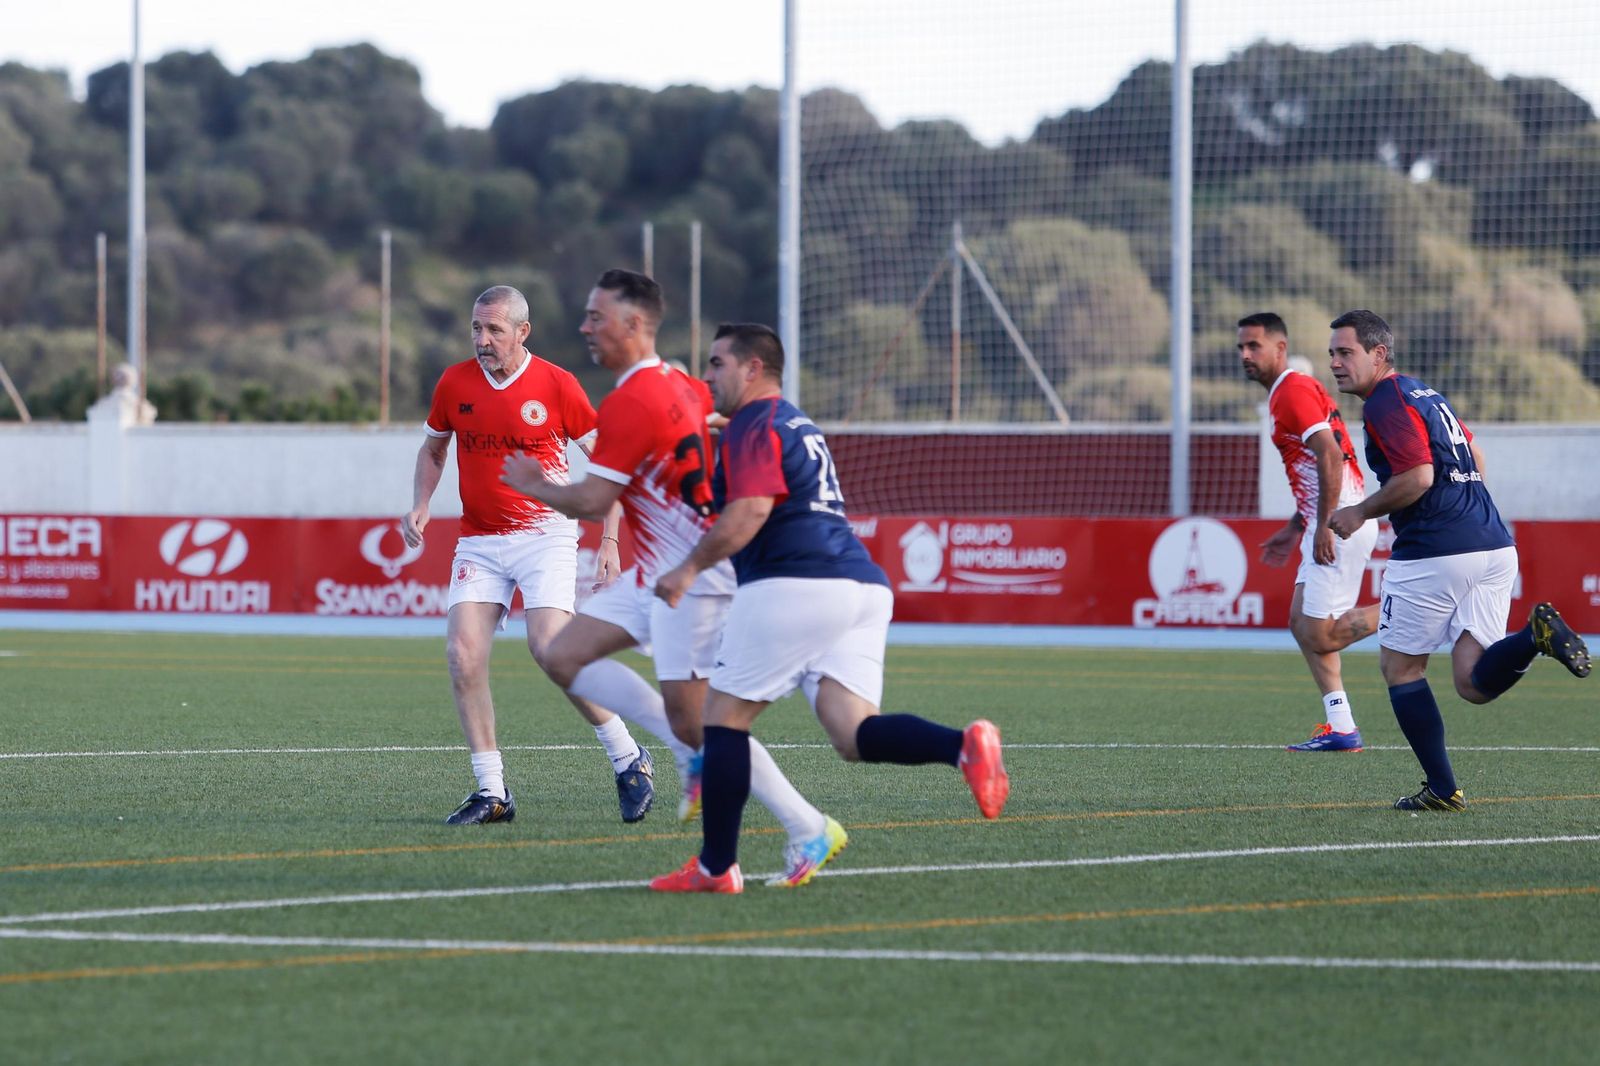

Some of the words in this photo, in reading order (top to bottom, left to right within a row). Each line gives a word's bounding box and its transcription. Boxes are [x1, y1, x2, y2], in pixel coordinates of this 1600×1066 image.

[950, 523, 1012, 545] GRUPO
[951, 547, 1067, 569] INMOBILIARIO
[135, 579, 270, 612] HYUNDAI
[315, 578, 449, 616] SSANGYON
